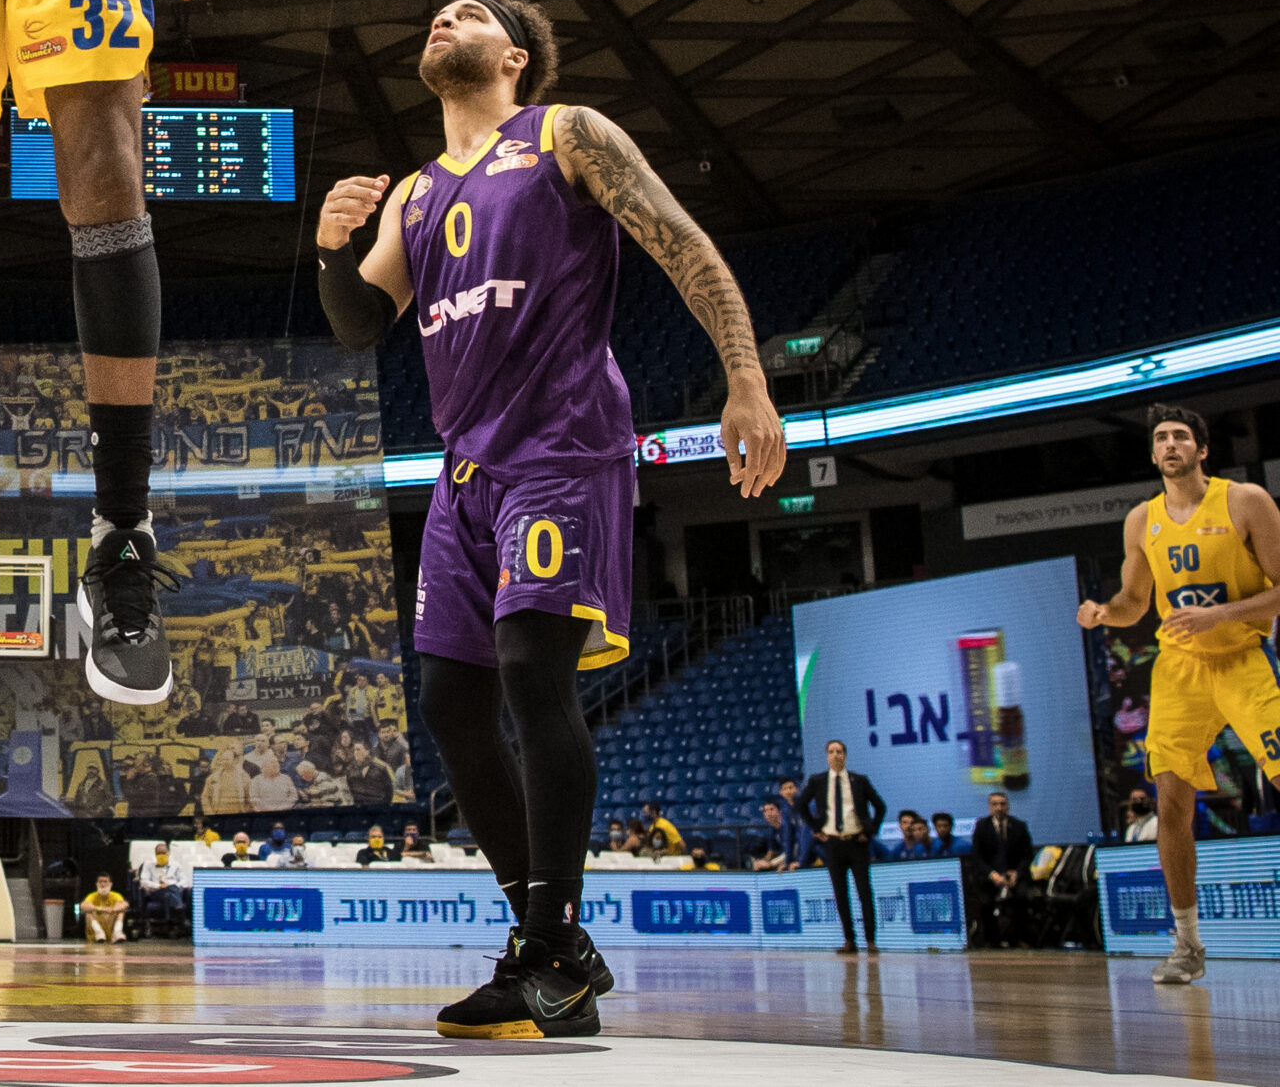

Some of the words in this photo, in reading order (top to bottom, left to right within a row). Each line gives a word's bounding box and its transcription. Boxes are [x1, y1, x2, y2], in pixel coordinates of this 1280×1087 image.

[174, 71, 237, 92] טוטו
[445, 202, 472, 258] 0
[417, 279, 526, 337] UNET
[816, 463, 828, 481] 7
[525, 519, 564, 578] 0
[1168, 543, 1200, 574] 50
[1177, 588, 1220, 609] OX
[865, 688, 970, 747] אב!
[223, 897, 303, 922] עמינח
[333, 898, 388, 926] טוב,
[397, 892, 476, 923] לחיות
[579, 893, 622, 923] ליש
[650, 899, 731, 925] עמינח
